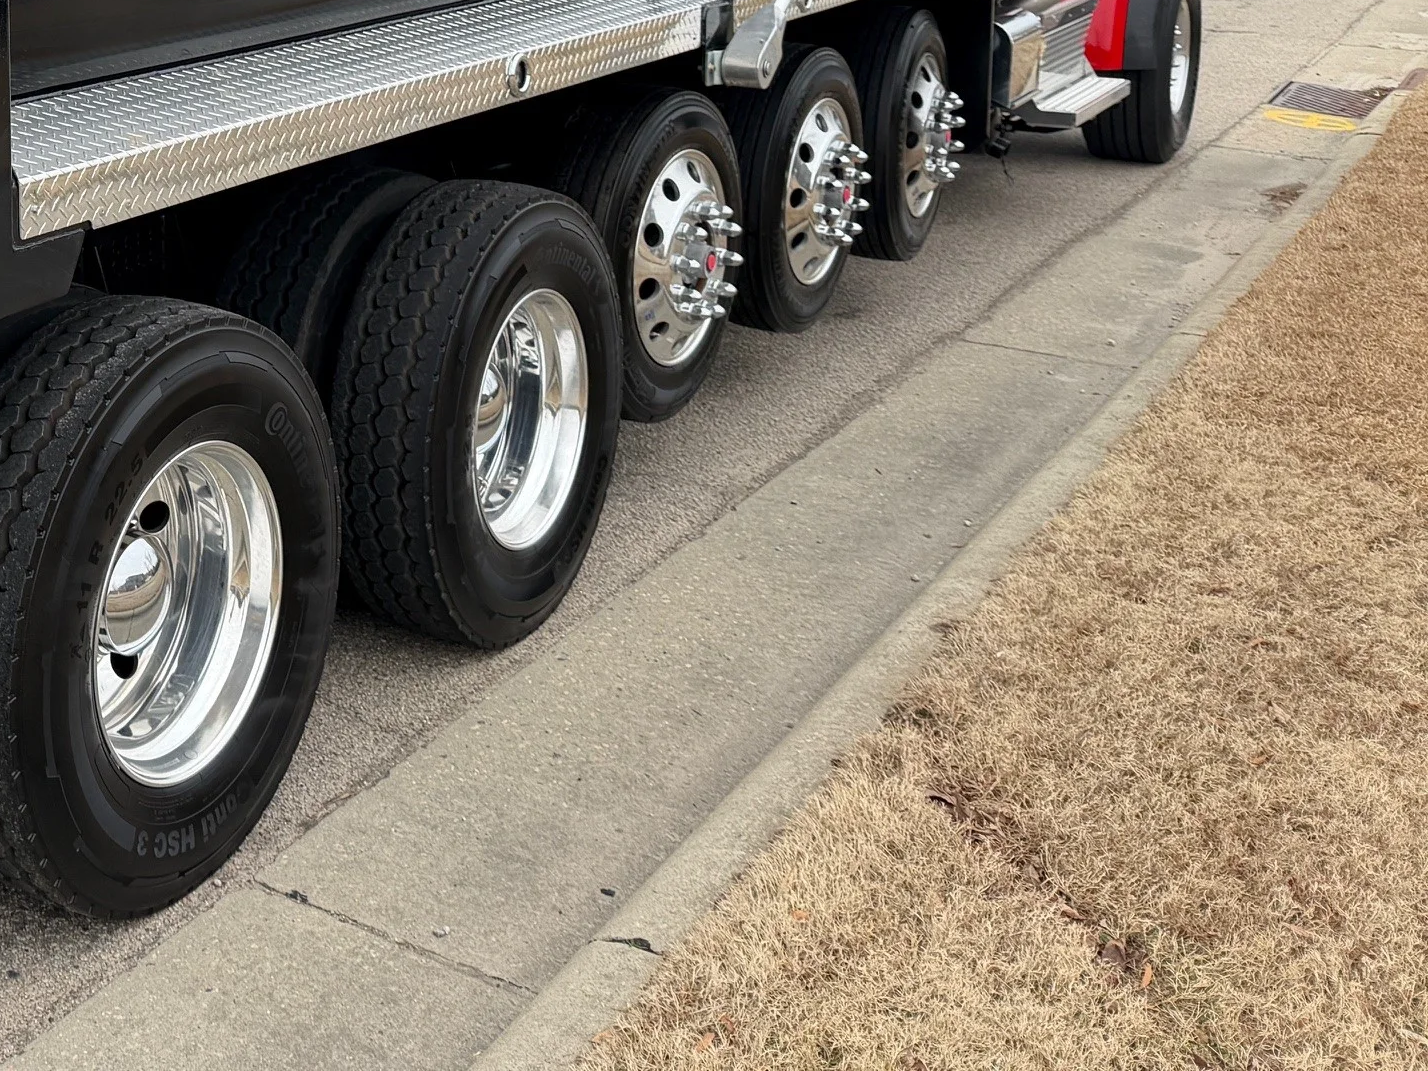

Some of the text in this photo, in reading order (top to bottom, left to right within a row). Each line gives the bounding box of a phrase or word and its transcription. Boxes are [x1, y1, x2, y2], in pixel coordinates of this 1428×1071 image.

[88, 541, 104, 565] R
[104, 457, 144, 525] 22.5
[137, 829, 149, 856] 3
[154, 823, 195, 859] HSC
